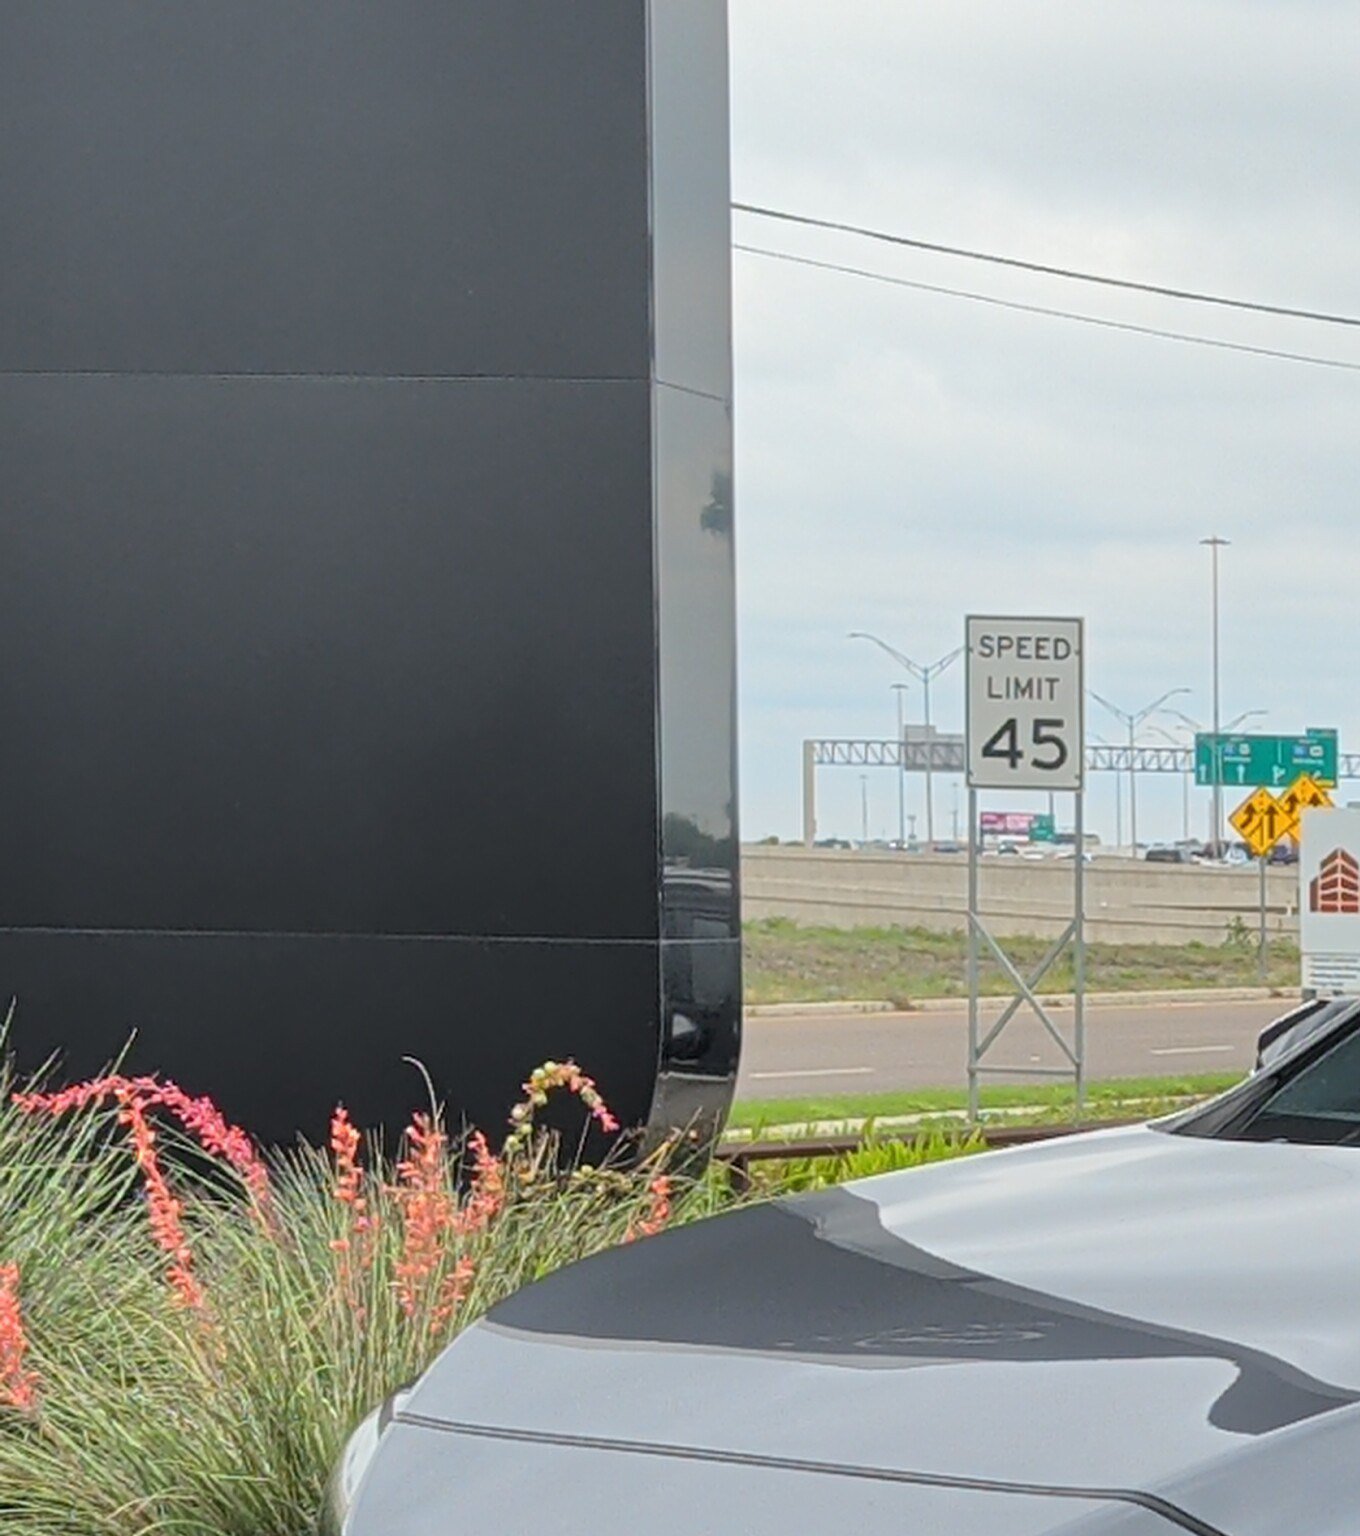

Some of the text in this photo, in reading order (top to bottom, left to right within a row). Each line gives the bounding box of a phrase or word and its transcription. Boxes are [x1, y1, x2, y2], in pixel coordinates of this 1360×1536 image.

[979, 635, 1071, 660] SPEED
[987, 676, 1060, 701] LIMIT
[981, 718, 1068, 771] 45
